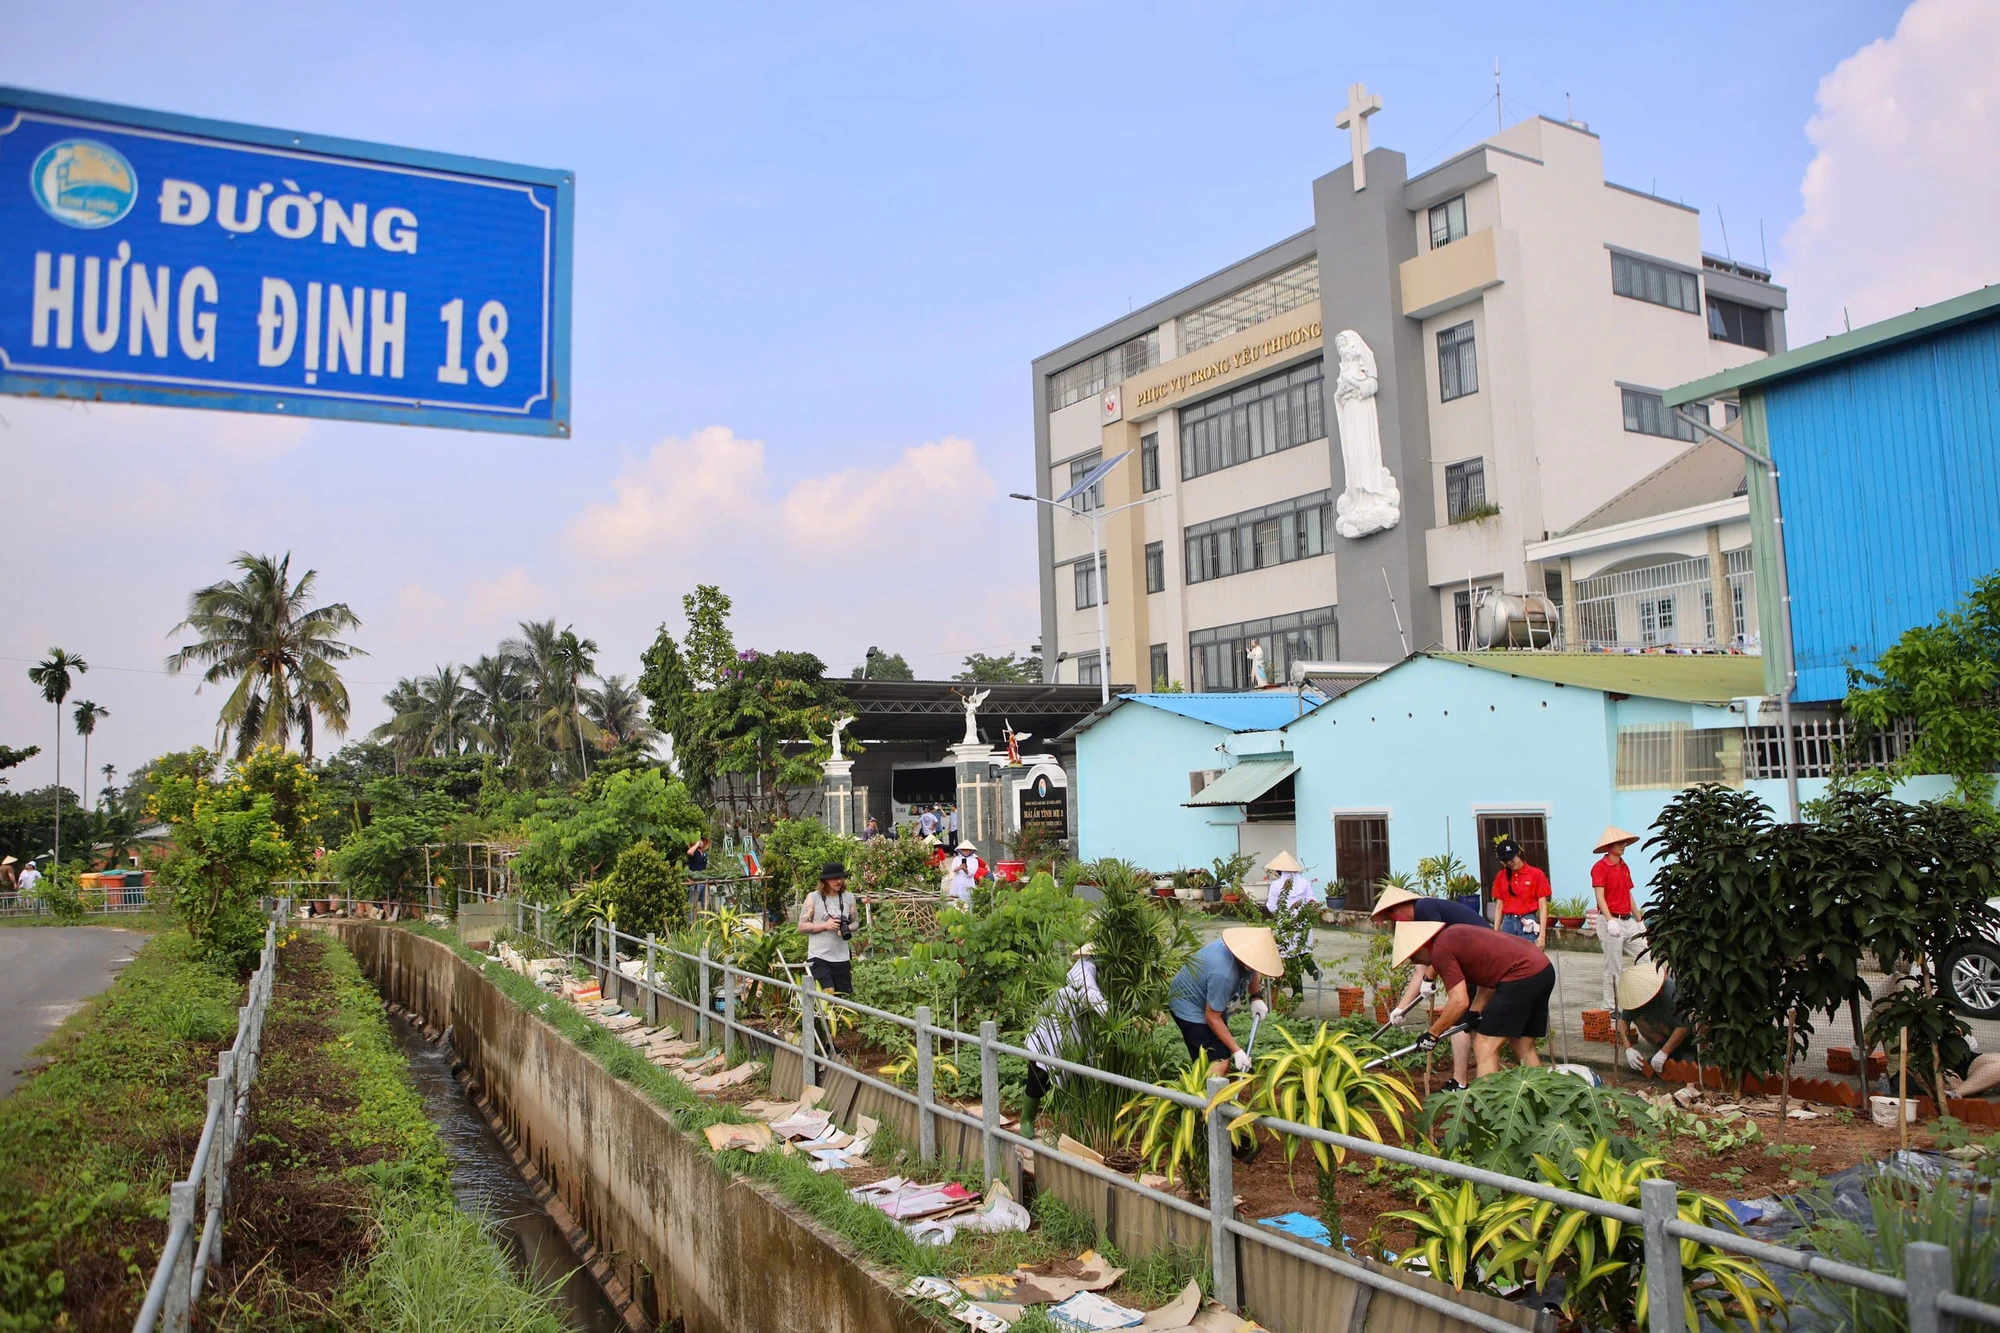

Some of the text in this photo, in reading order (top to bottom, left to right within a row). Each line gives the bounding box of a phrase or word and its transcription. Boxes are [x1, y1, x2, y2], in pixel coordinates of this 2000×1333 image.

[157, 178, 418, 254] ĐƯỜNG
[31, 240, 510, 387] HƯNG ĐỊNH 18
[1136, 321, 1323, 408] PHỤC VỤ TRONG YÊU THƯƠNG
